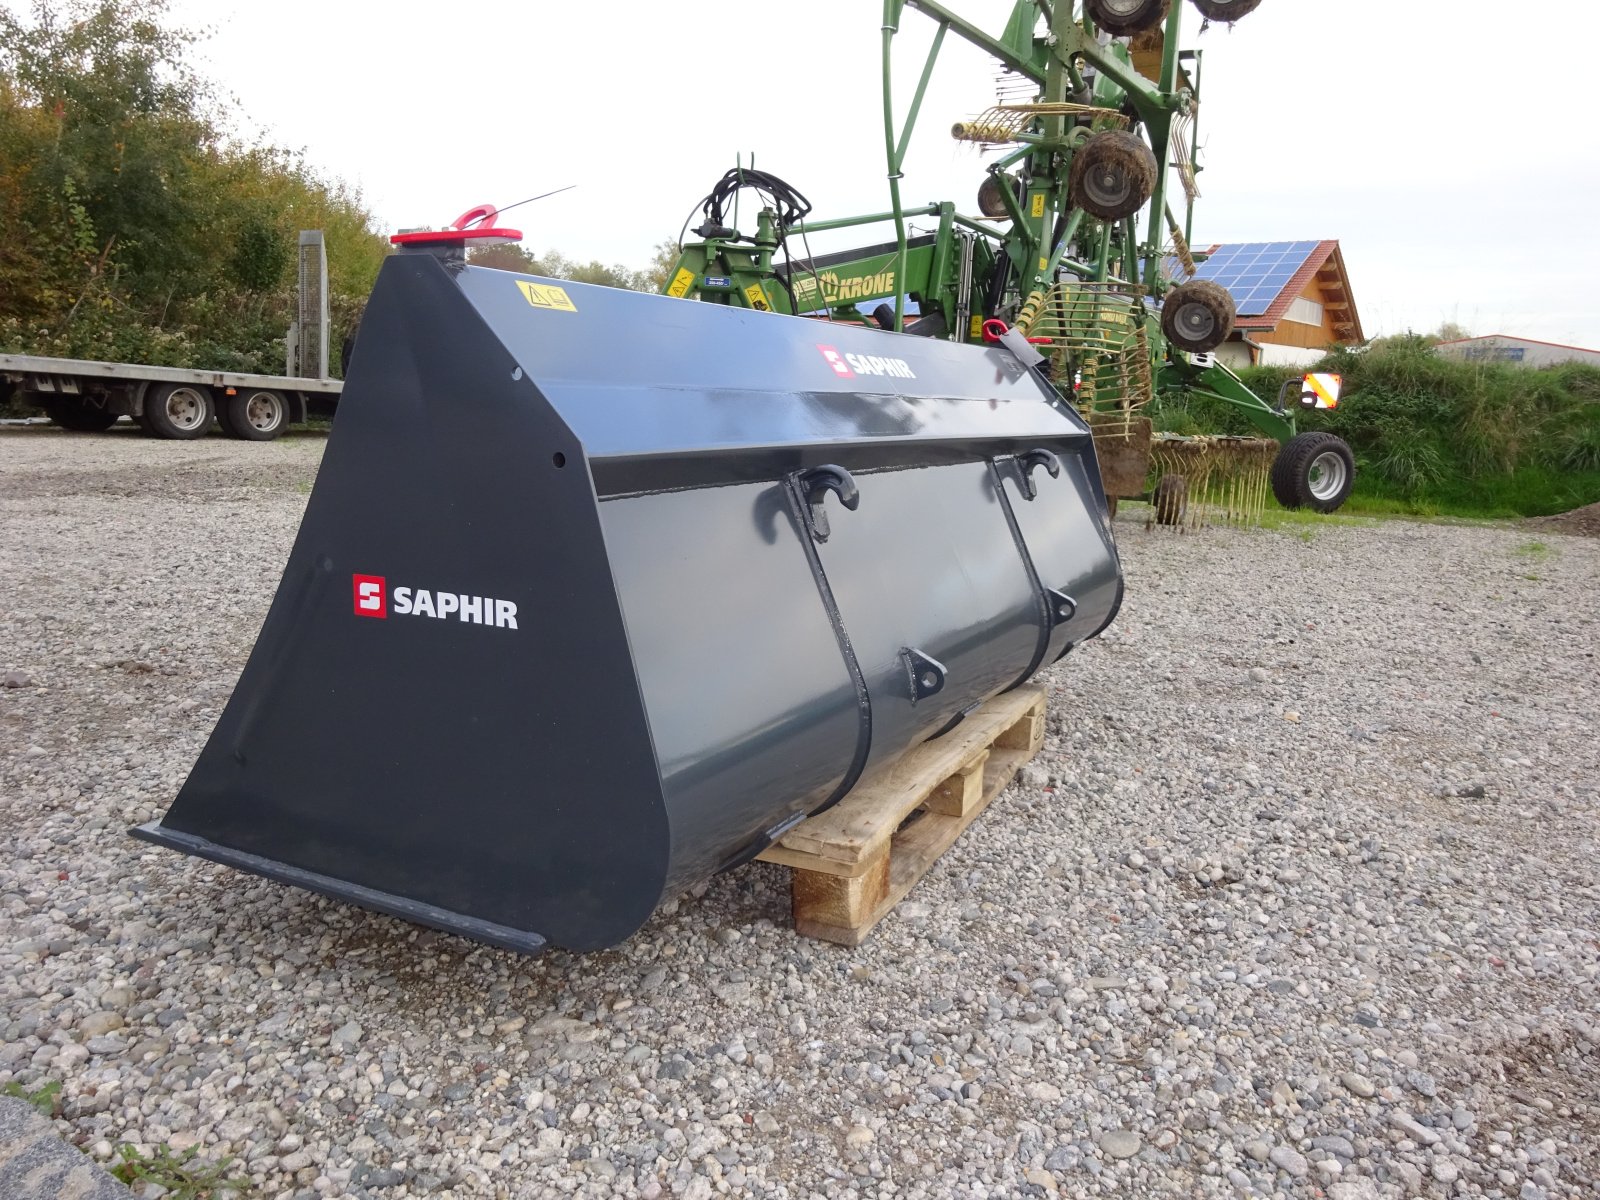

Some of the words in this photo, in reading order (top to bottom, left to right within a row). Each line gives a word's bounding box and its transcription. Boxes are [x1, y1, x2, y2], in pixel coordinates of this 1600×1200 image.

[839, 272, 895, 300] KRONE
[844, 352, 917, 379] SAPHIR
[393, 586, 519, 630] SAPHIR
